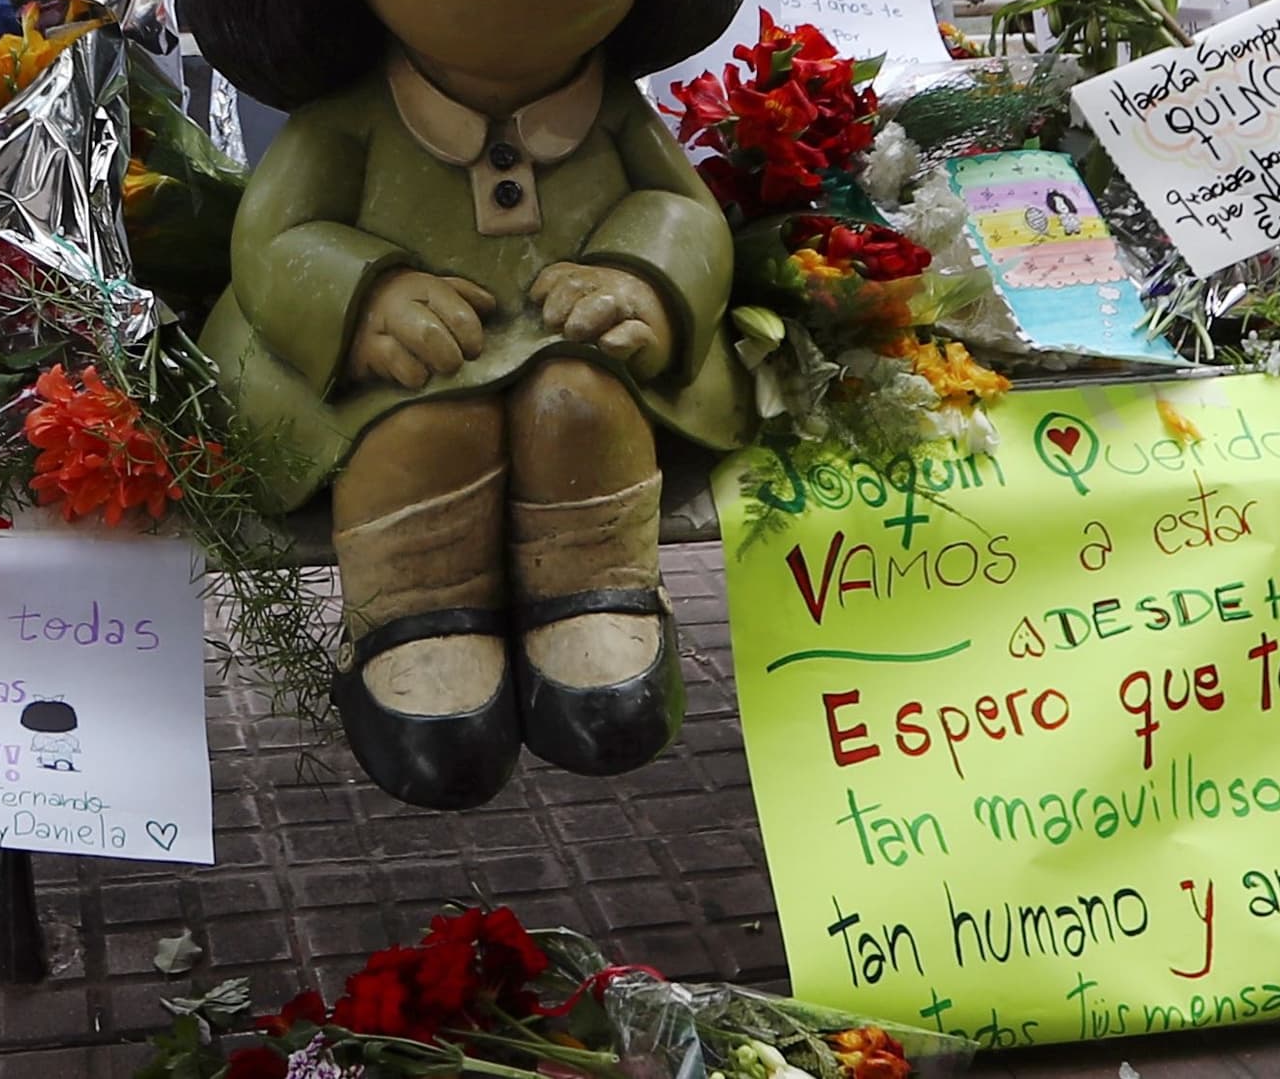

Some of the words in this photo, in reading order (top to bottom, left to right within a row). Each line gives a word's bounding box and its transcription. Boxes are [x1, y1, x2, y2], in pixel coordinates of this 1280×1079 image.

[1079, 521, 1113, 572] a
[1152, 469, 1258, 556] estar
[7, 600, 161, 651] todas
[1044, 580, 1252, 651] DESDE
[821, 687, 1070, 780] Espero
[1120, 663, 1225, 770] que
[12, 810, 127, 850] Daniela
[836, 787, 950, 867] tan
[827, 895, 924, 988] tan
[942, 879, 1149, 968] humano
[1168, 877, 1214, 980] y
